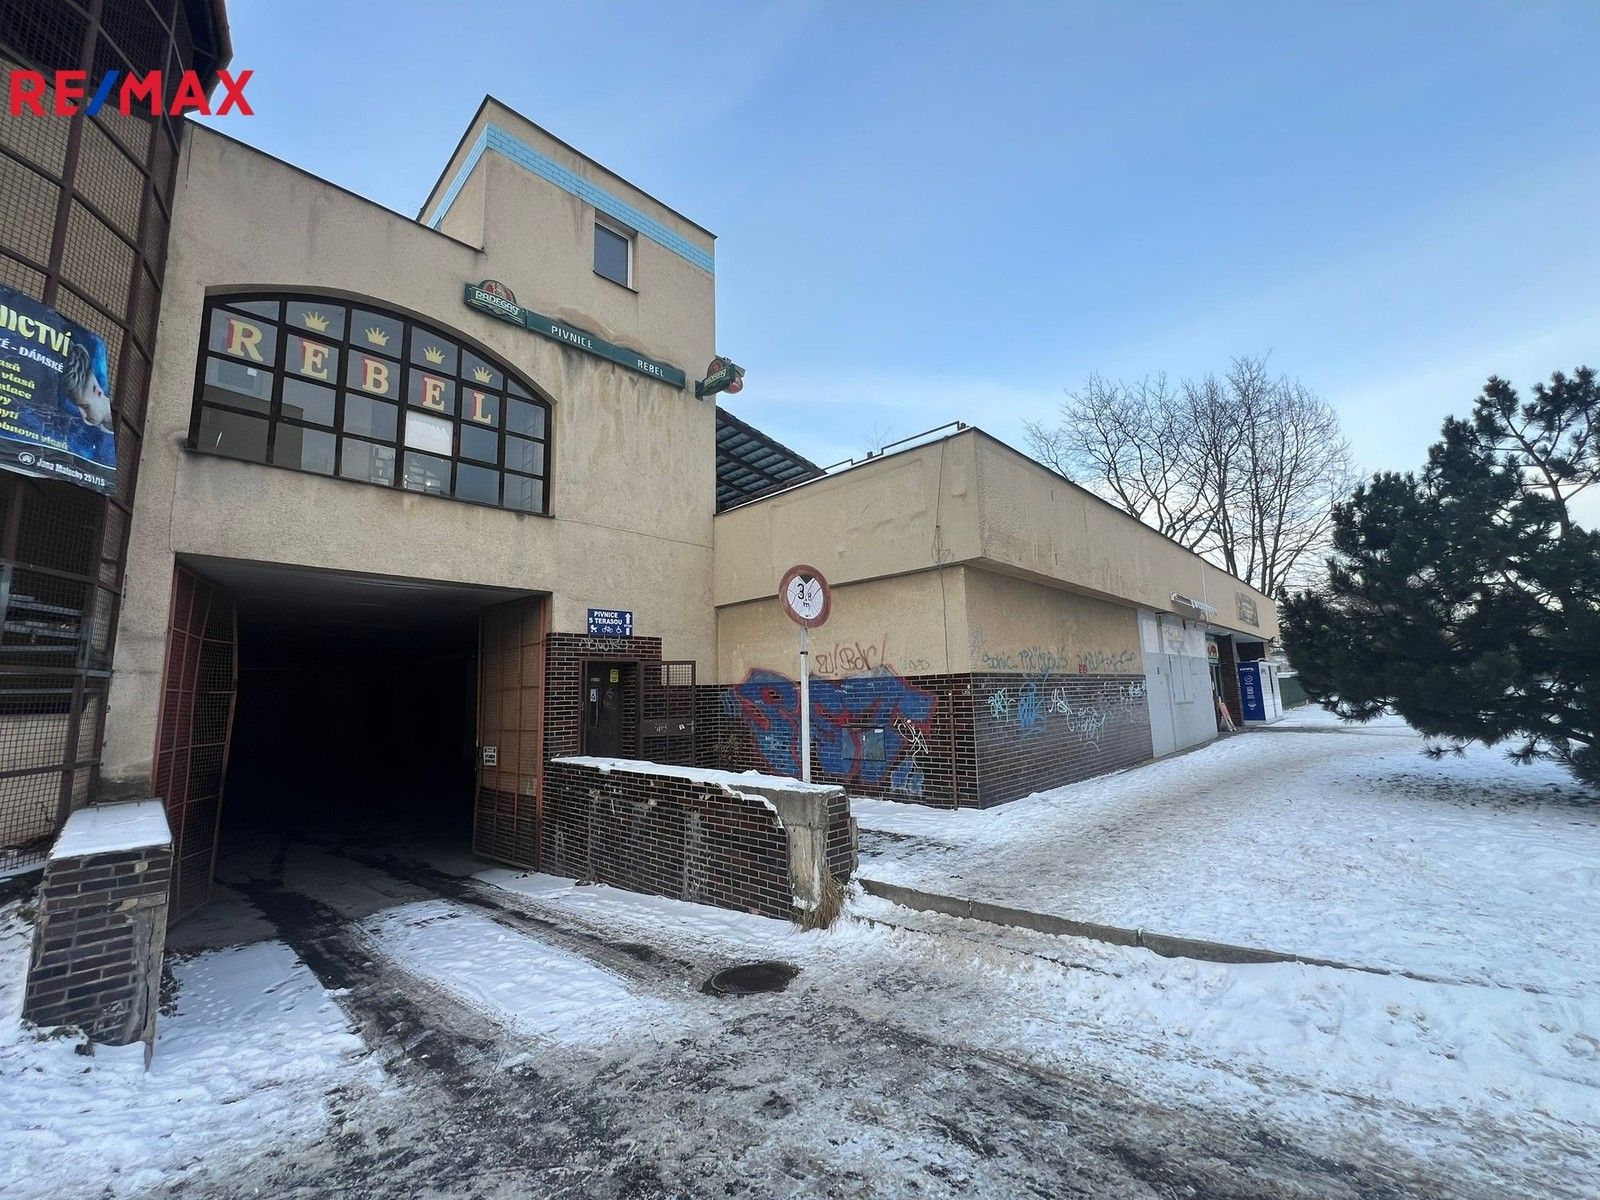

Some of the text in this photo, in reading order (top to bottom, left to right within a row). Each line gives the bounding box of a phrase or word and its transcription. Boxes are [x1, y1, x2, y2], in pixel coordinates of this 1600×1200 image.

[475, 290, 521, 315] RADEGAST
[19, 346, 65, 373] DÁMSKÉ
[551, 325, 664, 377] PIVNICE REBEL
[1, 371, 36, 390] vlasů
[226, 316, 493, 424] REBEL
[594, 610, 619, 619] PIVNICE
[594, 617, 623, 625] TERASOU
